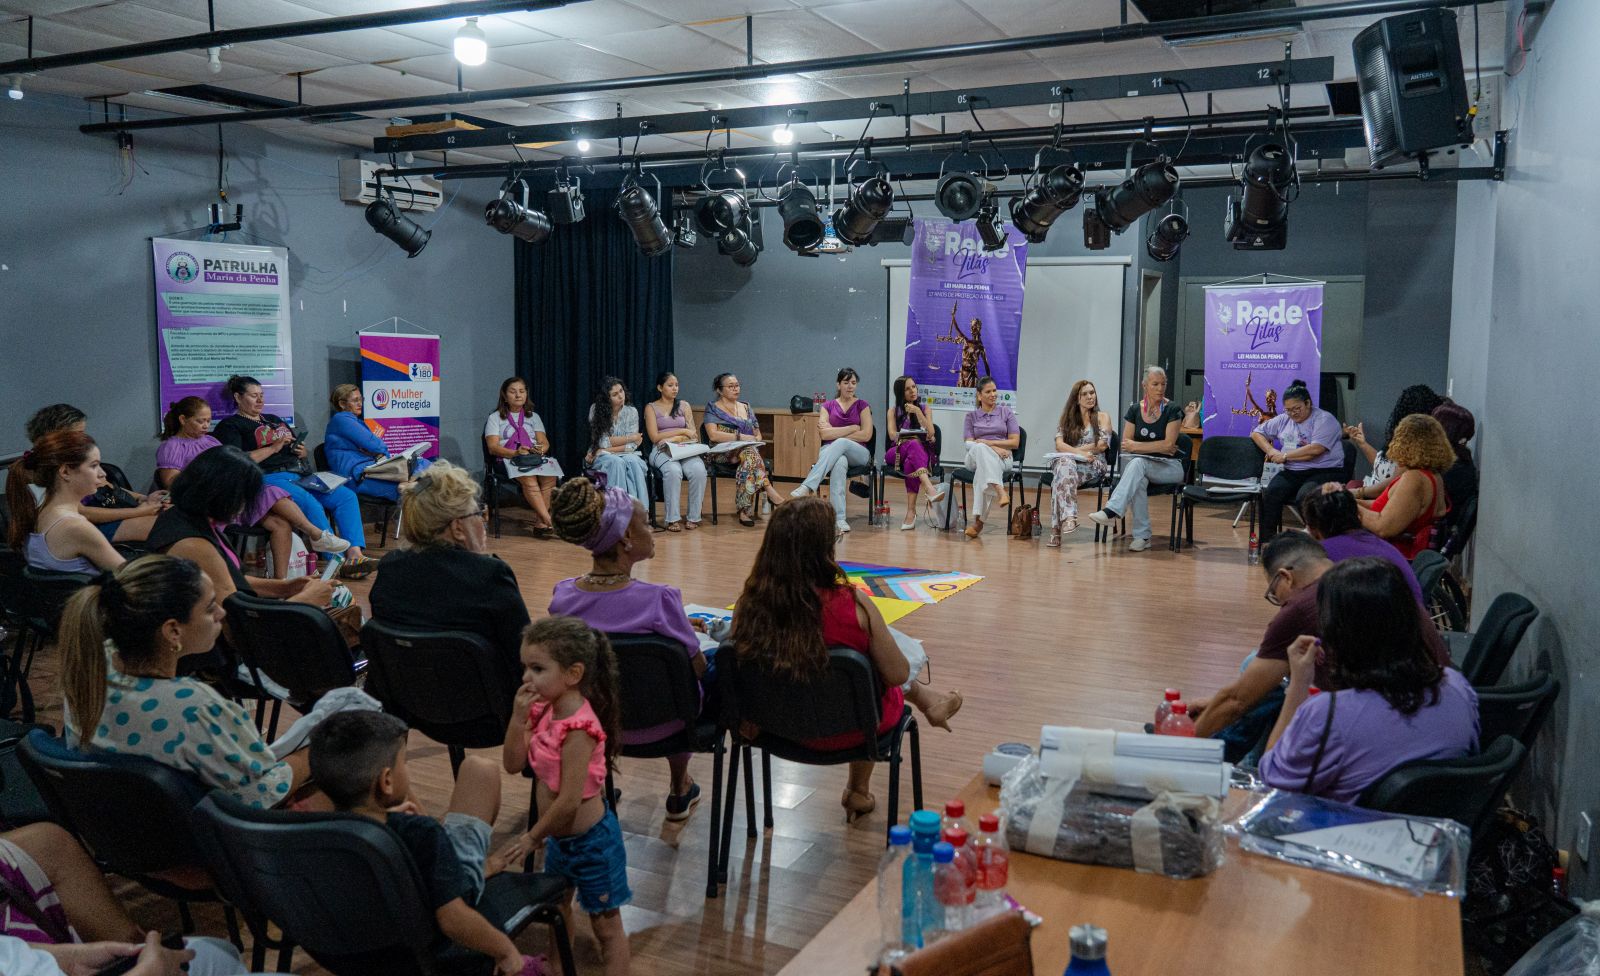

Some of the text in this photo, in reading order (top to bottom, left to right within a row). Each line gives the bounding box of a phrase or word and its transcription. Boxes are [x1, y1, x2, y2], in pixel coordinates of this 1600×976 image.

[1257, 68, 1270, 79] 12
[1152, 77, 1162, 88] 11
[447, 136, 456, 144] 02
[203, 258, 278, 274] PATRULHA
[206, 272, 277, 284] Maria da Penha
[1236, 298, 1303, 326] Rede
[1245, 315, 1285, 350] Lilás
[419, 370, 432, 378] 180
[391, 388, 423, 399] Mulher
[391, 399, 431, 411] Protegida
